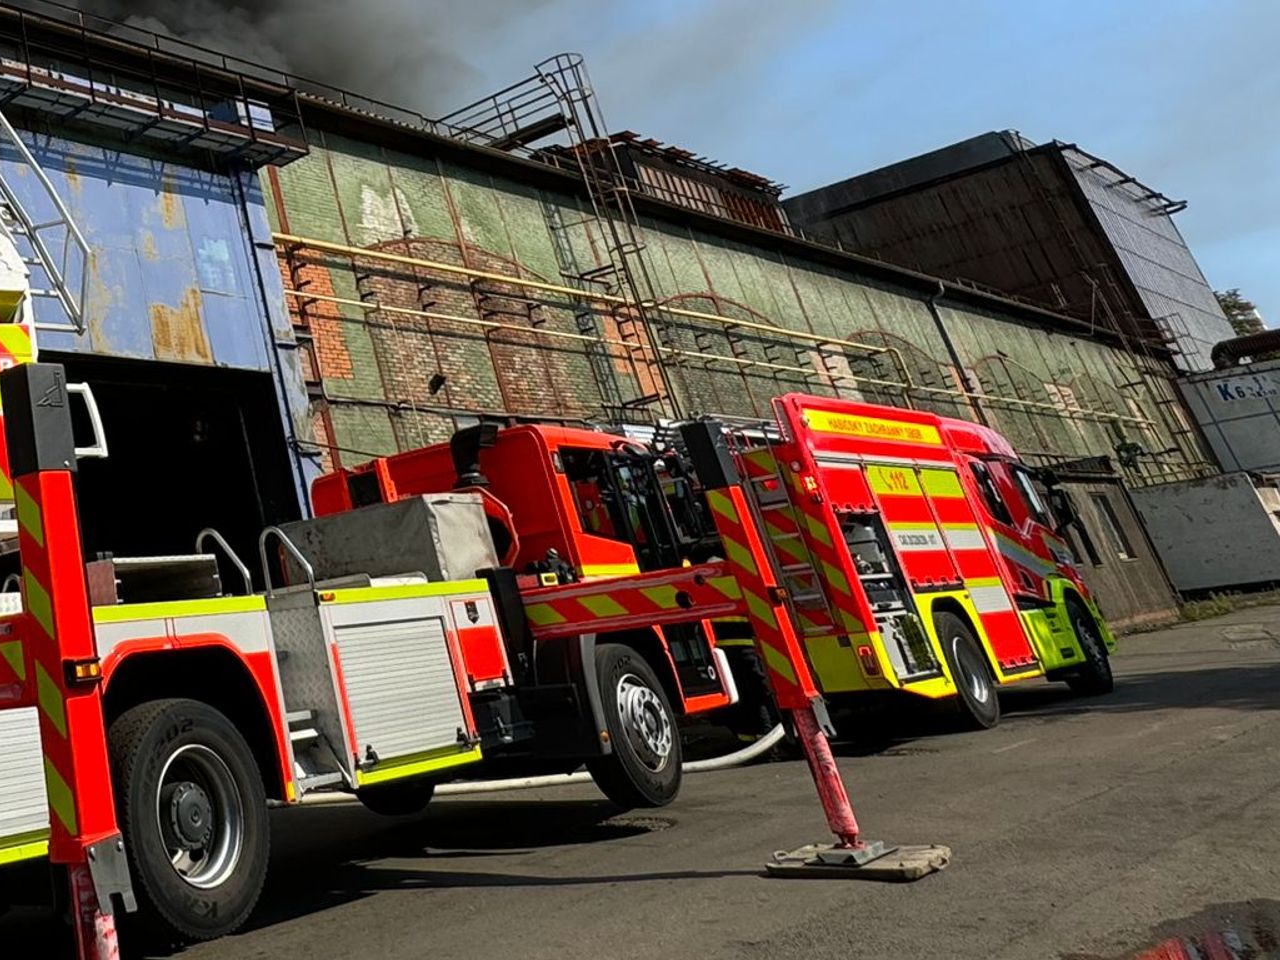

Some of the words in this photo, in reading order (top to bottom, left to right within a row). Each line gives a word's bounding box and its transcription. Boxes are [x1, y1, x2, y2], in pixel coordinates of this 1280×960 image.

[1216, 383, 1235, 401] K
[1235, 386, 1246, 398] 6
[889, 470, 909, 489] 112
